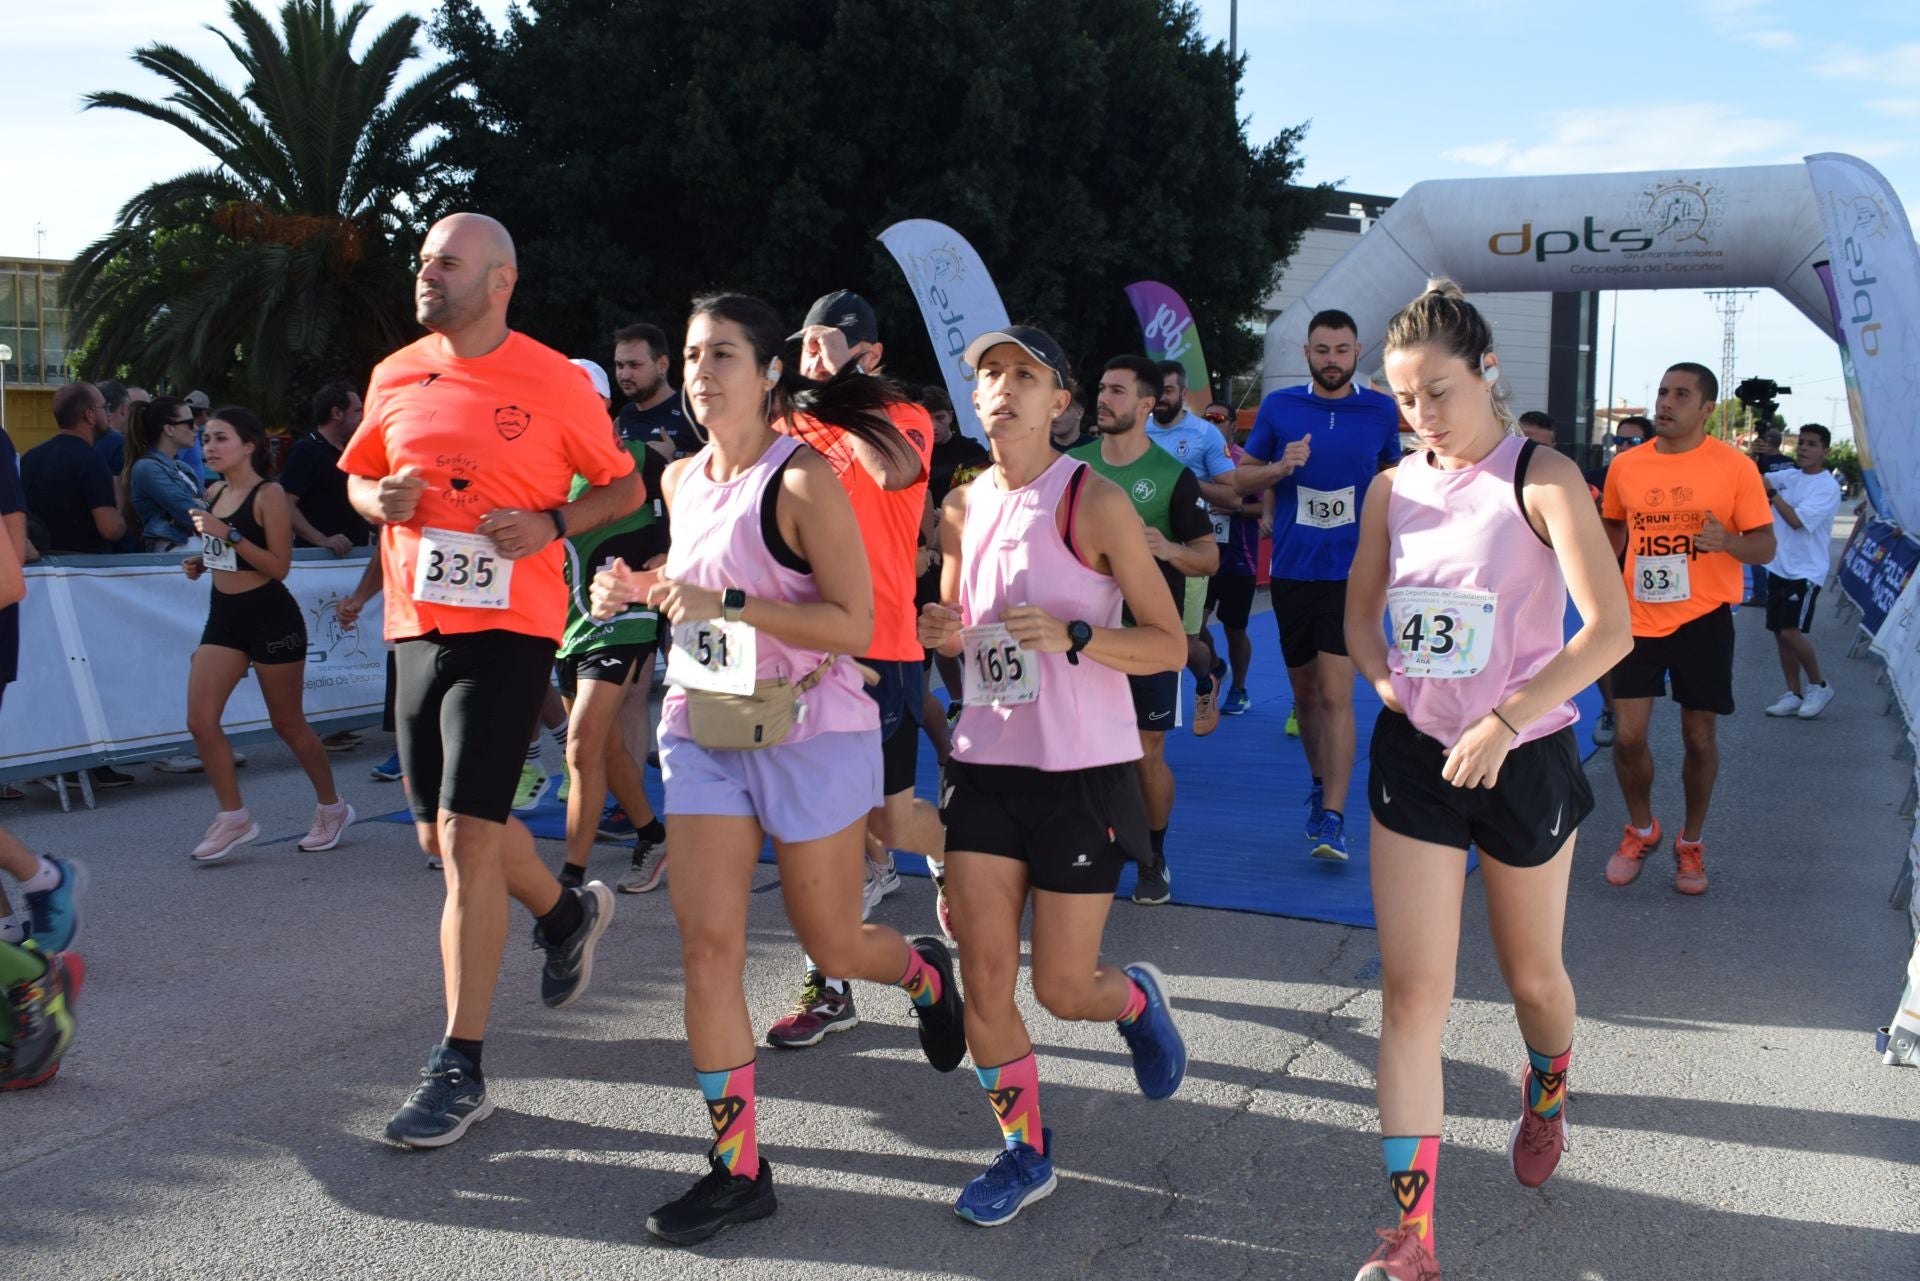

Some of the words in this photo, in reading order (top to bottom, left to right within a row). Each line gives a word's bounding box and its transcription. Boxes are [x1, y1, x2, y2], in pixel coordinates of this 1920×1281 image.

[1488, 216, 1653, 263] dpts
[1643, 263, 1662, 273] de
[1665, 262, 1725, 274] Deportes
[1307, 499, 1345, 519] 130
[1646, 514, 1671, 524] RUN
[1673, 512, 1700, 522] FOR
[426, 550, 494, 588] 335
[1643, 569, 1670, 590] 83
[1402, 613, 1455, 655] 43
[698, 630, 728, 667] 51
[976, 646, 1023, 682] 165
[336, 672, 349, 685] de
